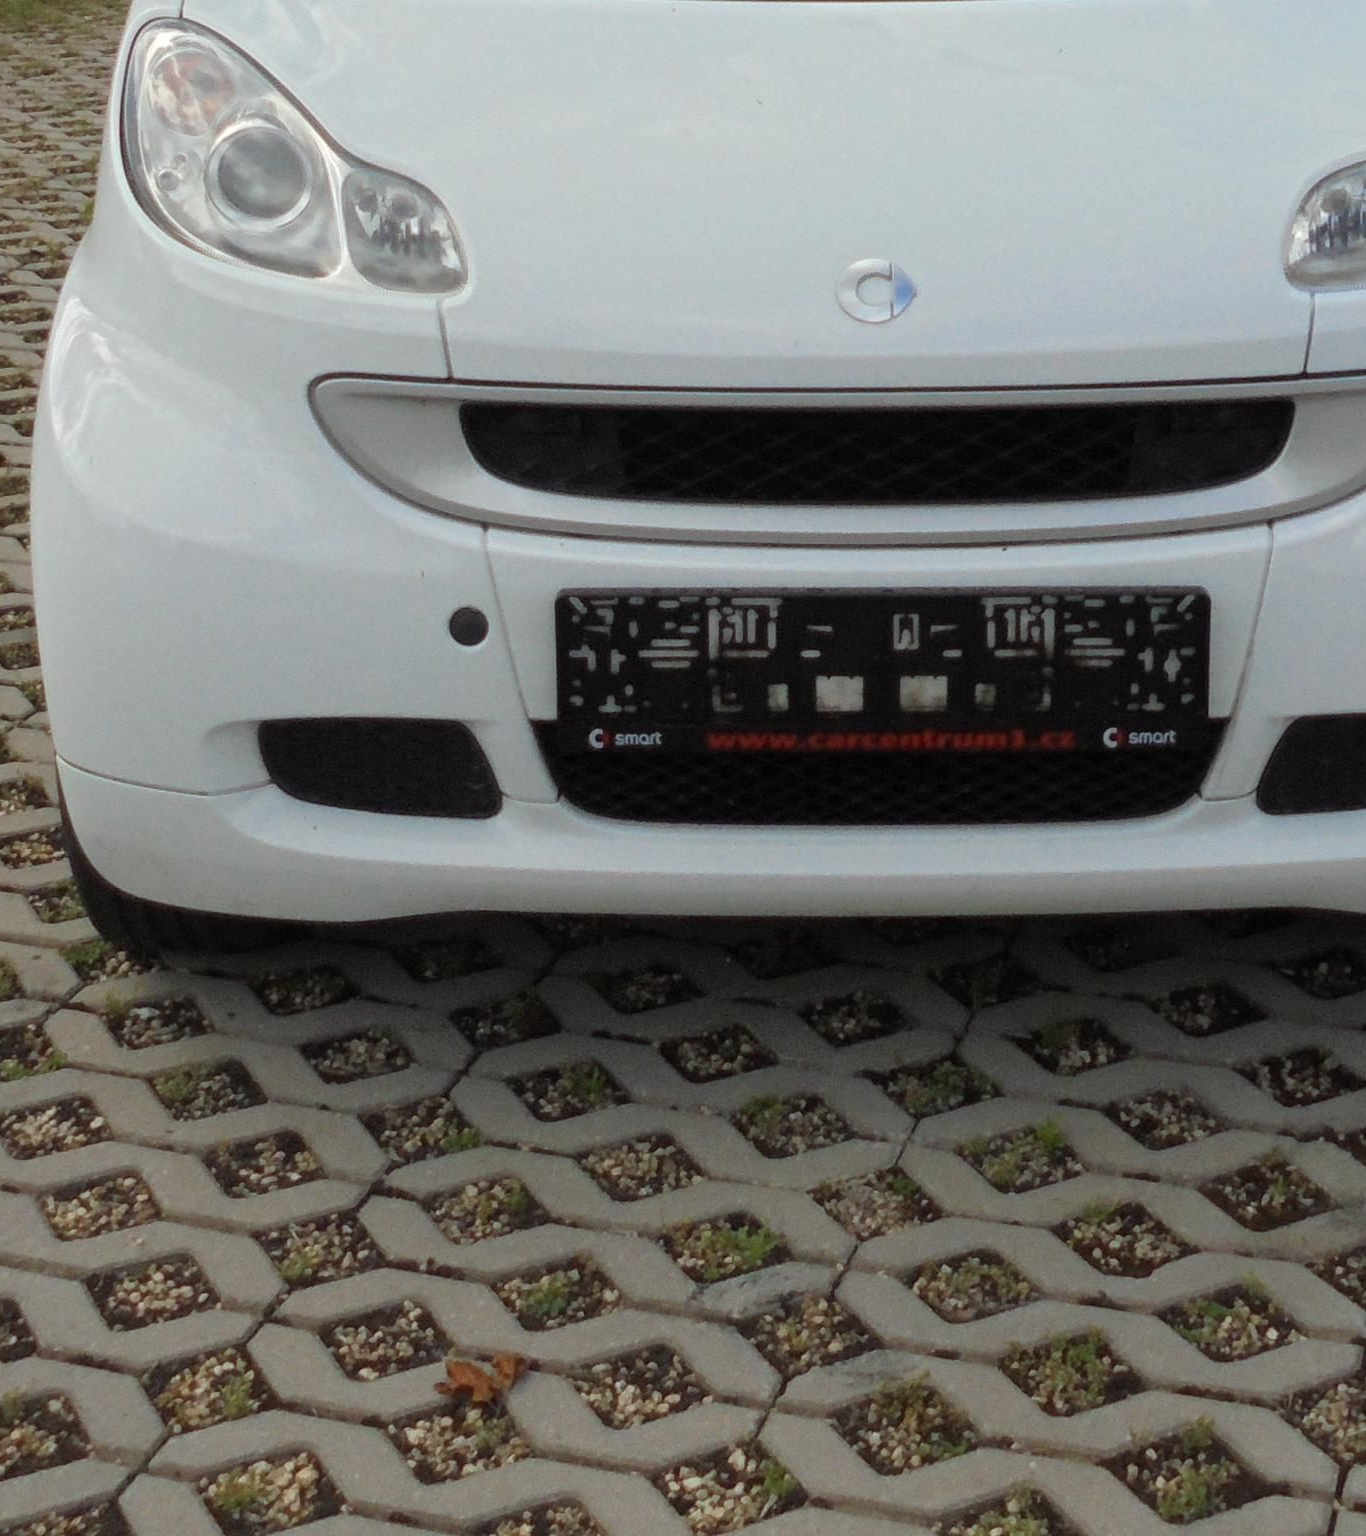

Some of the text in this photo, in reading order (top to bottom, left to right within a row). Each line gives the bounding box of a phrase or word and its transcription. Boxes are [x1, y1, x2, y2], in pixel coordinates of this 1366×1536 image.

[615, 730, 663, 746] smart
[706, 730, 1075, 751] www.carcentrum1.cz
[1128, 729, 1177, 745] smart
